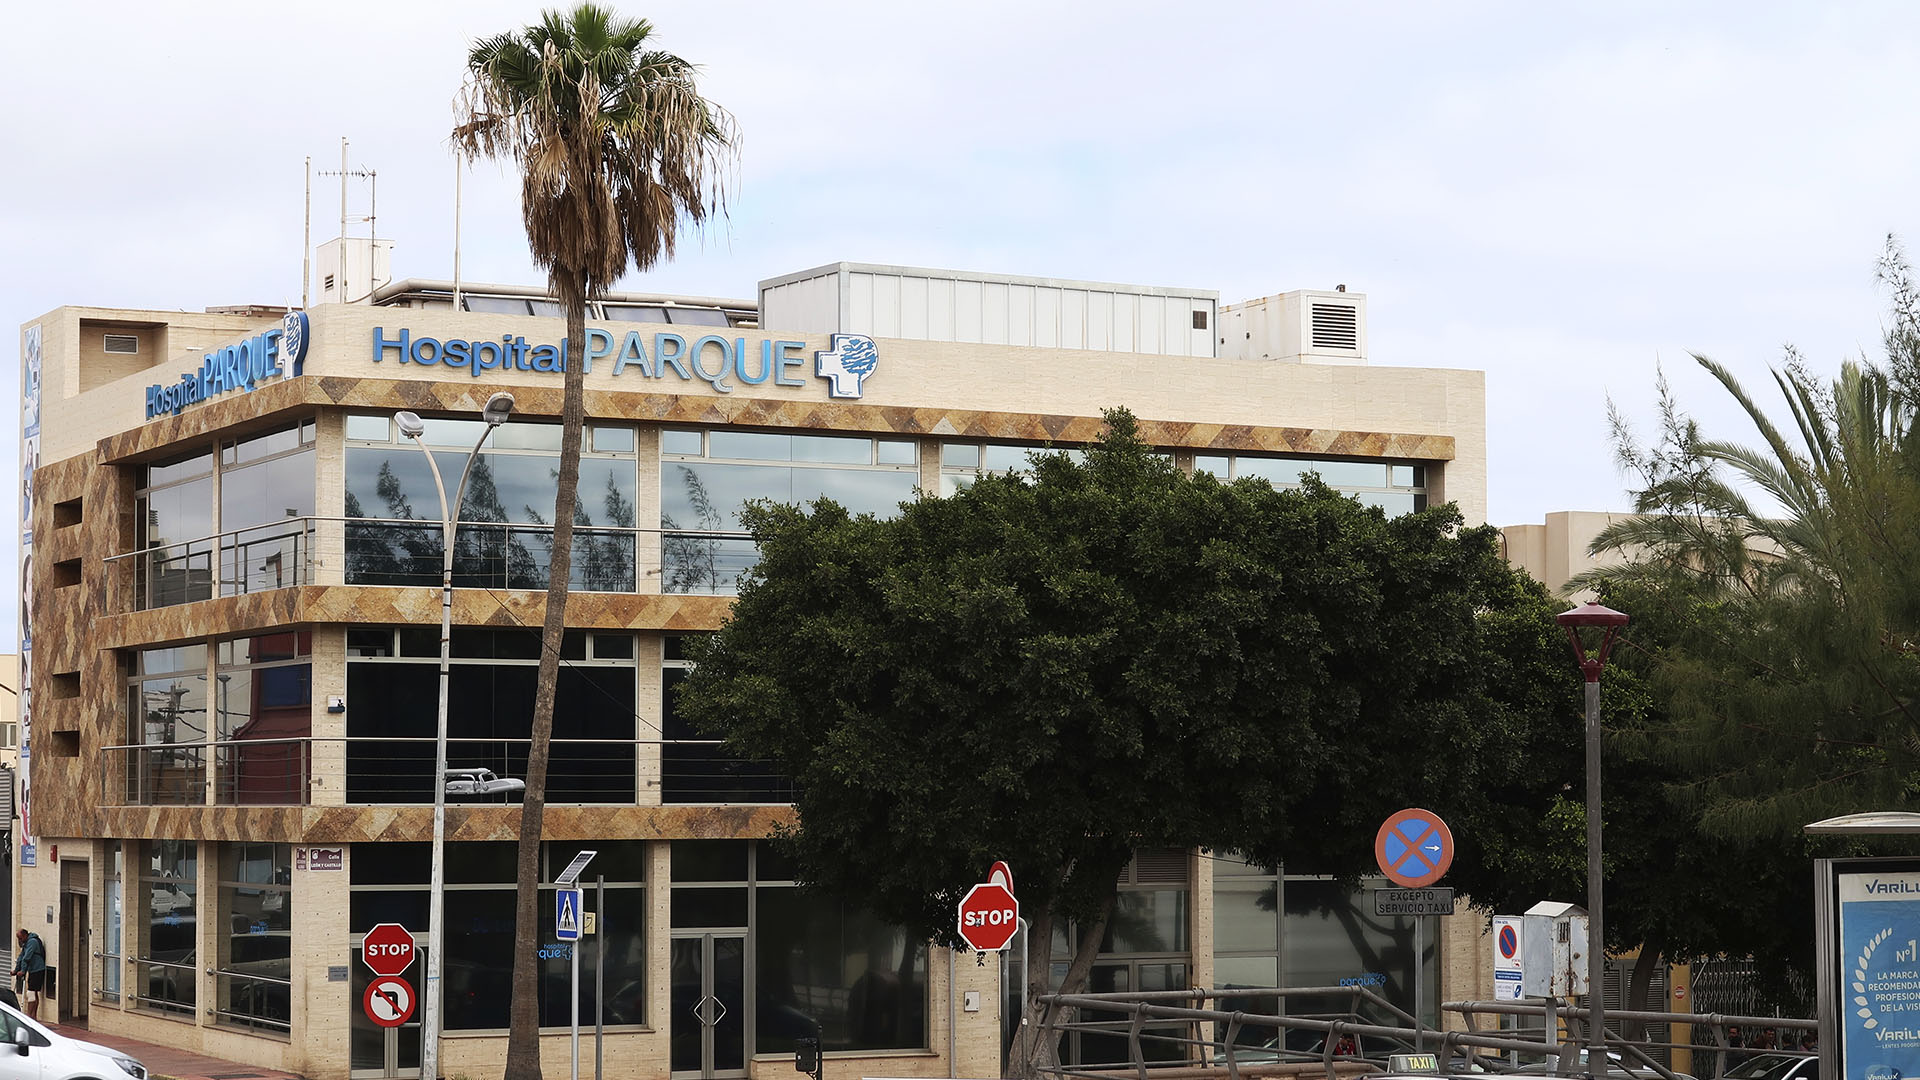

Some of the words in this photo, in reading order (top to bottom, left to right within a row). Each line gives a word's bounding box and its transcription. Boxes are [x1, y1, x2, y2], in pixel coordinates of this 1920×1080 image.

[373, 327, 567, 377] Hospital
[582, 328, 806, 393] PARQUE
[146, 367, 205, 421] Hospital
[203, 329, 283, 399] PARQUE
[1390, 891, 1434, 901] EXCEPTO
[1379, 903, 1425, 913] SERVICIO
[1427, 903, 1450, 913] TAXI
[964, 909, 1014, 927] STOP
[368, 943, 410, 956] STOP
[1877, 972, 1888, 980] LA
[1890, 971, 1919, 980] MARCA
[1880, 1004, 1892, 1012] DE
[1893, 1003, 1904, 1012] LA
[1408, 1056, 1430, 1069] TAXI
